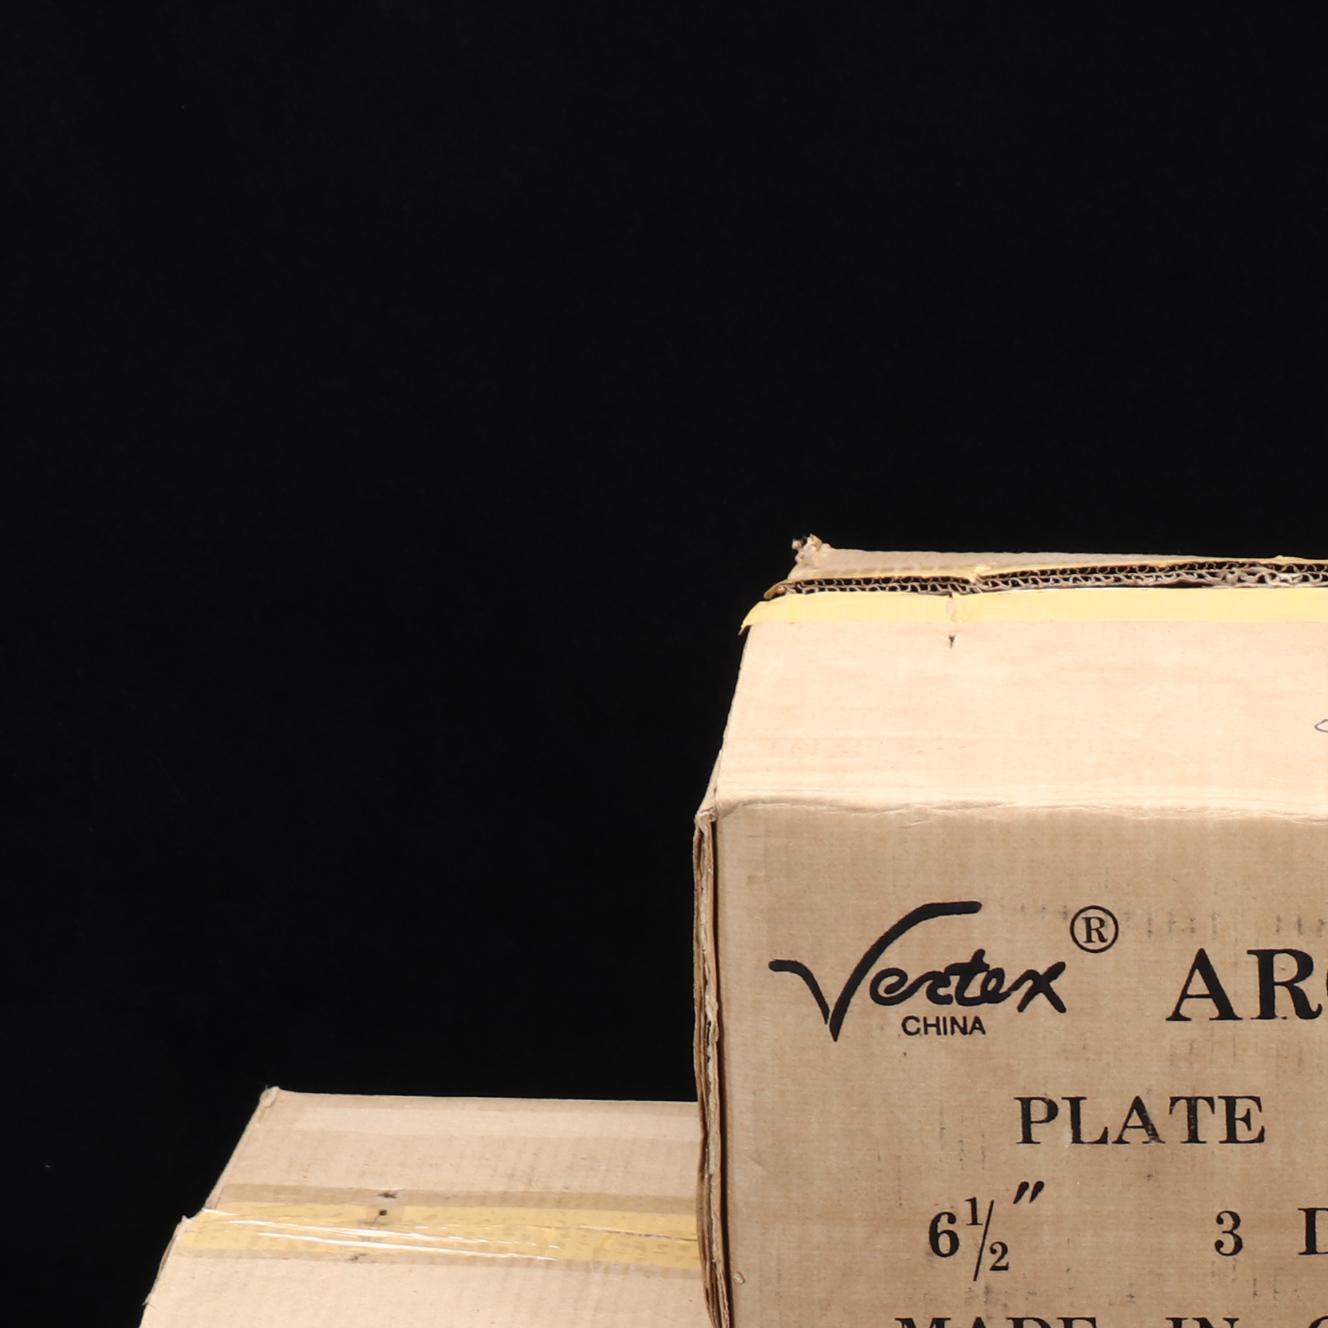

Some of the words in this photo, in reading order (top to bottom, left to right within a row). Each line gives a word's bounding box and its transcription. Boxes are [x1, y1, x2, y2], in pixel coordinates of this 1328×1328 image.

[768, 900, 1067, 1042] Vertex
[900, 1015, 987, 1037] CHINA
[1013, 1095, 1266, 1145] PLATE
[1214, 1210, 1244, 1257] 3
